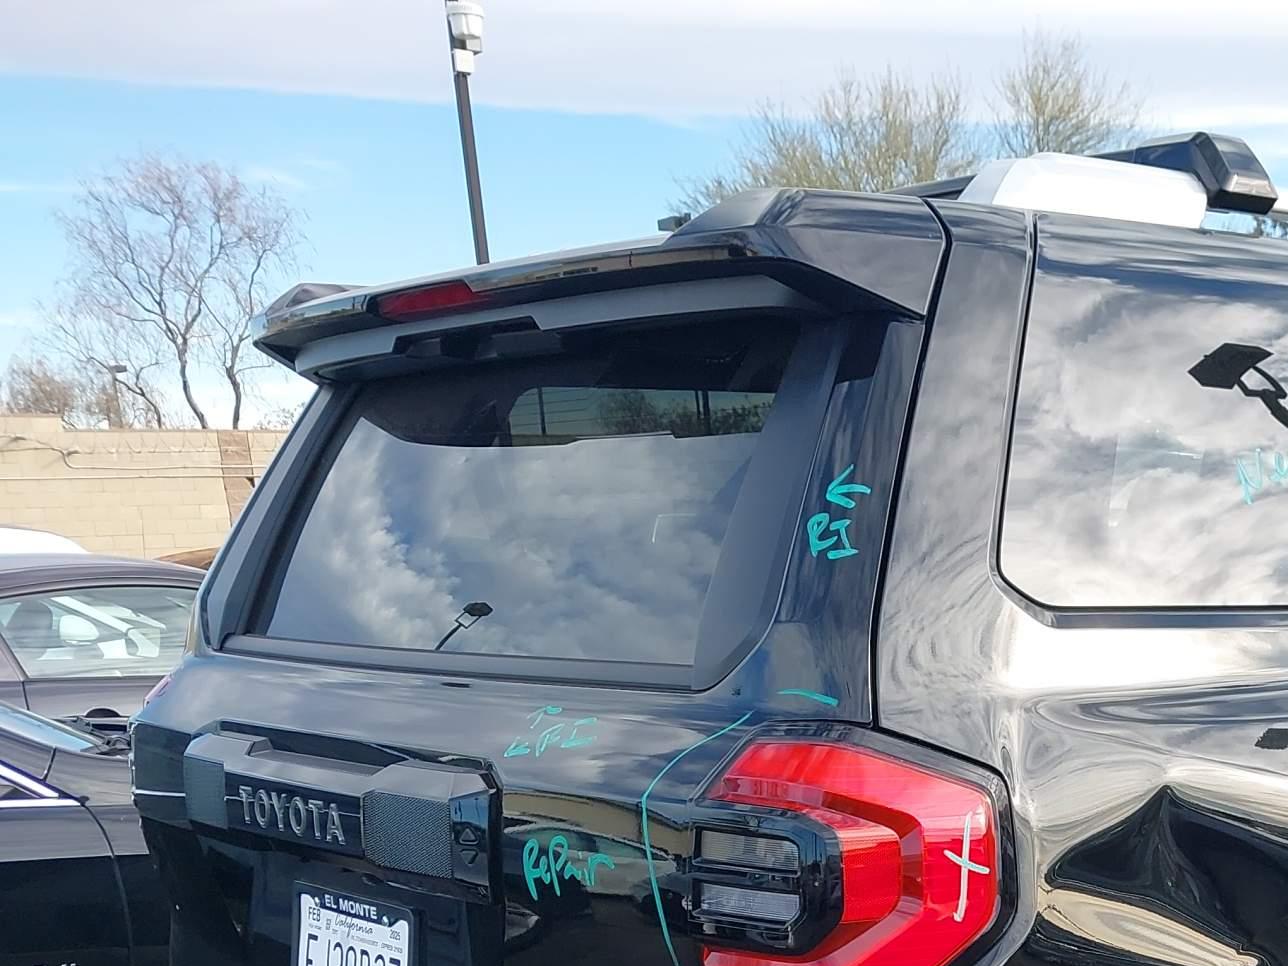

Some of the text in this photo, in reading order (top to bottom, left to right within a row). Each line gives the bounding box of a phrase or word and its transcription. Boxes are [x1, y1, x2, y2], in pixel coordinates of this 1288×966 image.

[239, 785, 347, 846] TOYOTA
[308, 907, 321, 923] FEB
[324, 894, 378, 920] EL MONTE
[334, 914, 374, 938] California
